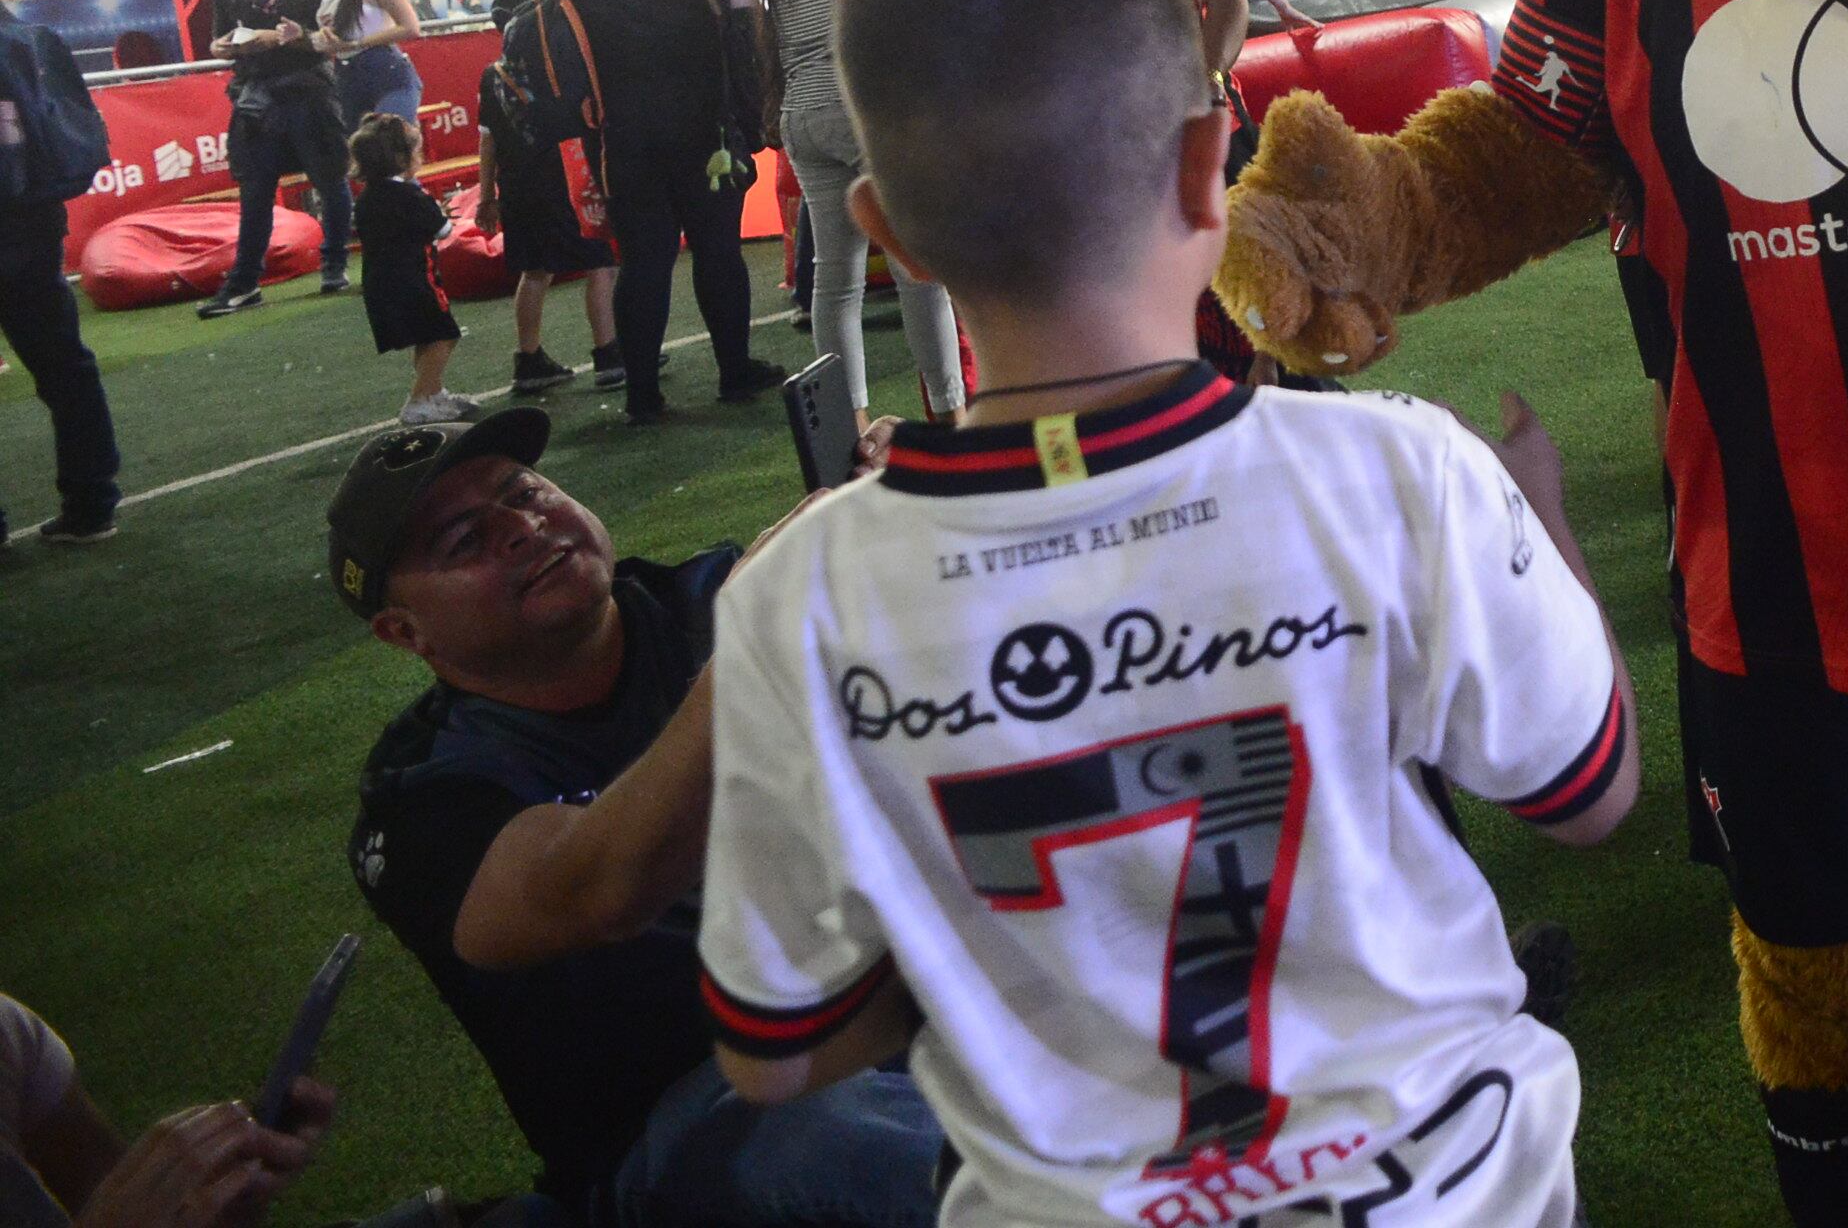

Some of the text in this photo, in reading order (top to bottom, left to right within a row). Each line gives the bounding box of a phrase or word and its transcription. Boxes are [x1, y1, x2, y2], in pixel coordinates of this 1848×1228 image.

[86, 159, 144, 196] oja
[937, 554, 973, 579] LA
[1089, 522, 1125, 551] AL
[840, 605, 1367, 741] Dos Pinos
[926, 704, 1312, 1184] 7
